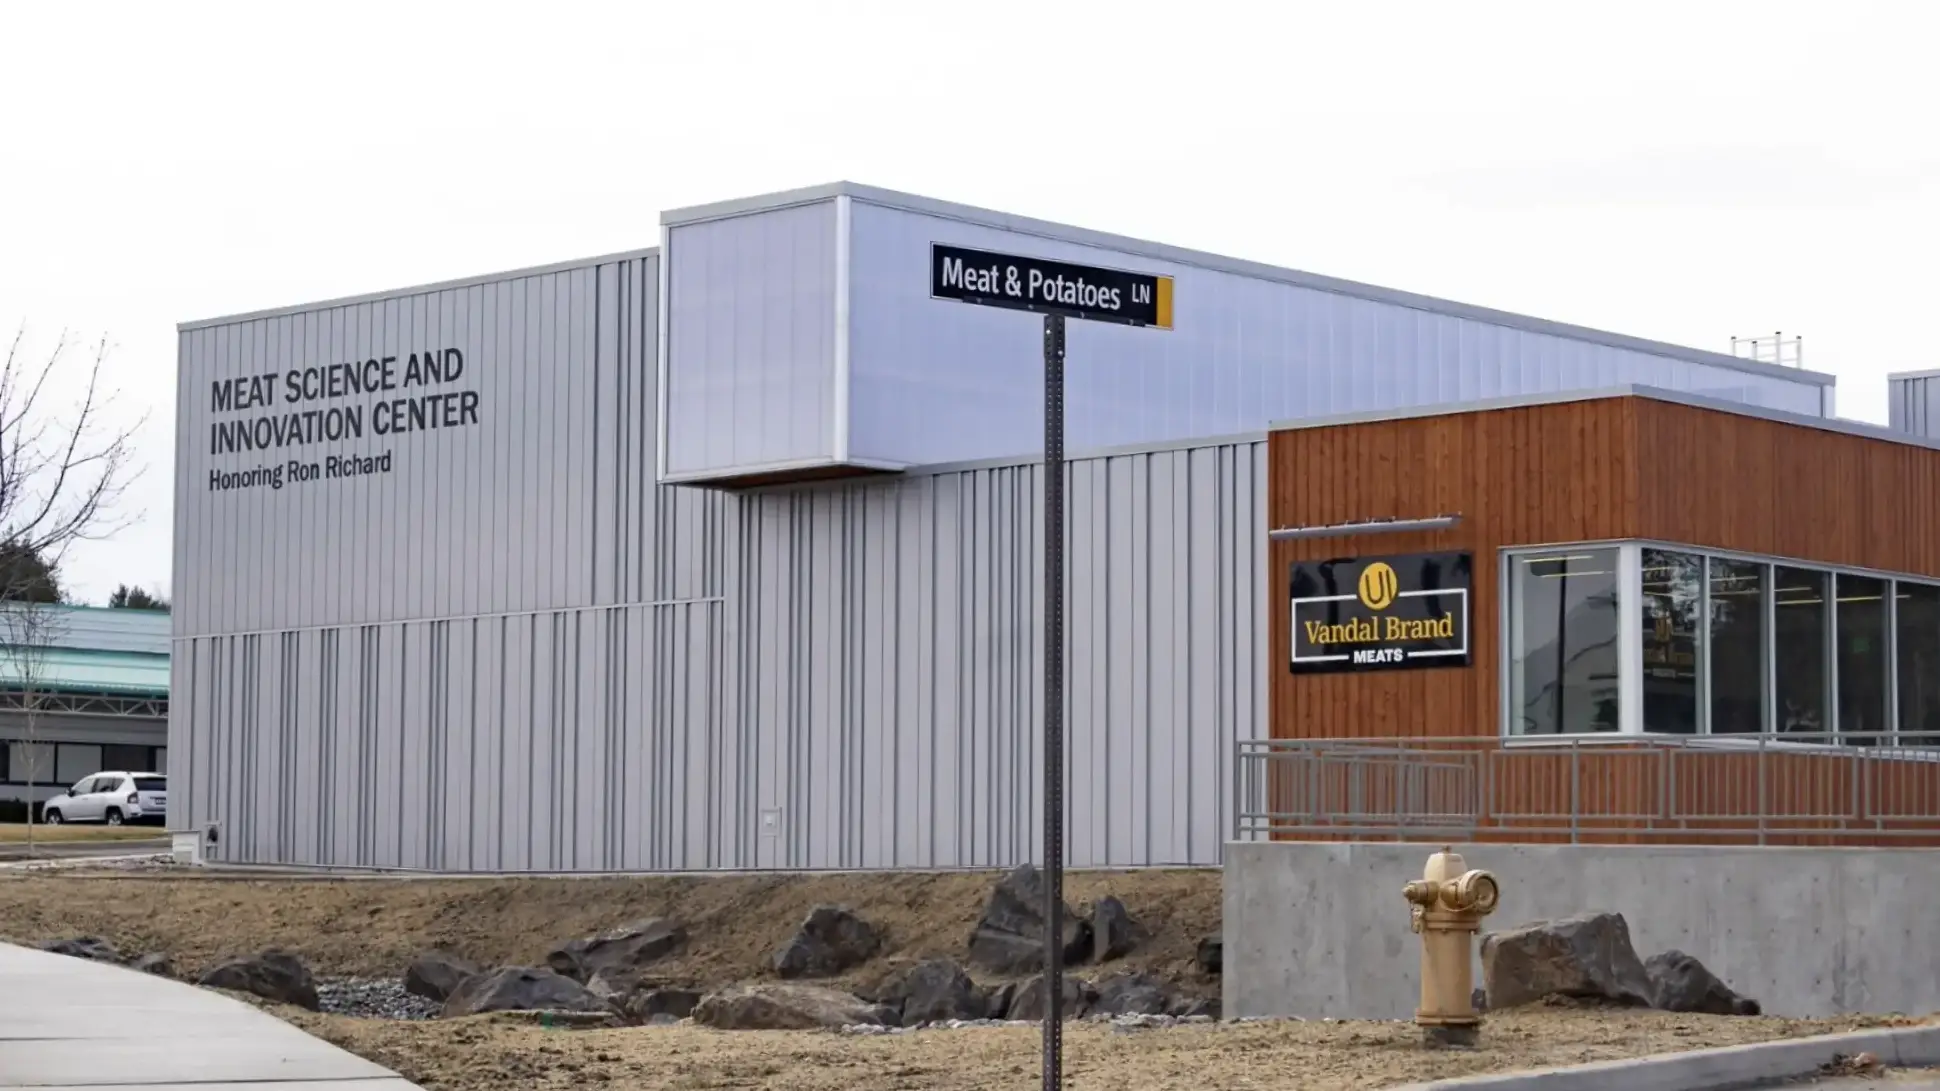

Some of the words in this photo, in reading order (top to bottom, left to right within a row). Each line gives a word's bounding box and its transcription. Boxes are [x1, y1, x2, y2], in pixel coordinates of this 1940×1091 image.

[942, 257, 1000, 294] Meat
[1005, 265, 1022, 297] &
[1028, 269, 1121, 310] Potatoes
[1131, 283, 1151, 304] LN
[211, 373, 279, 413] MEAT
[285, 356, 396, 403] SCIENCE
[403, 348, 464, 388] AND
[210, 404, 363, 455] INNOVATION
[372, 390, 479, 436] CENTER
[208, 464, 283, 491] Honoring
[287, 460, 320, 484] Ron
[325, 450, 392, 479] Richard
[1305, 616, 1380, 645] Vandal
[1385, 611, 1454, 641] Brand
[1353, 648, 1403, 664] MEATS
